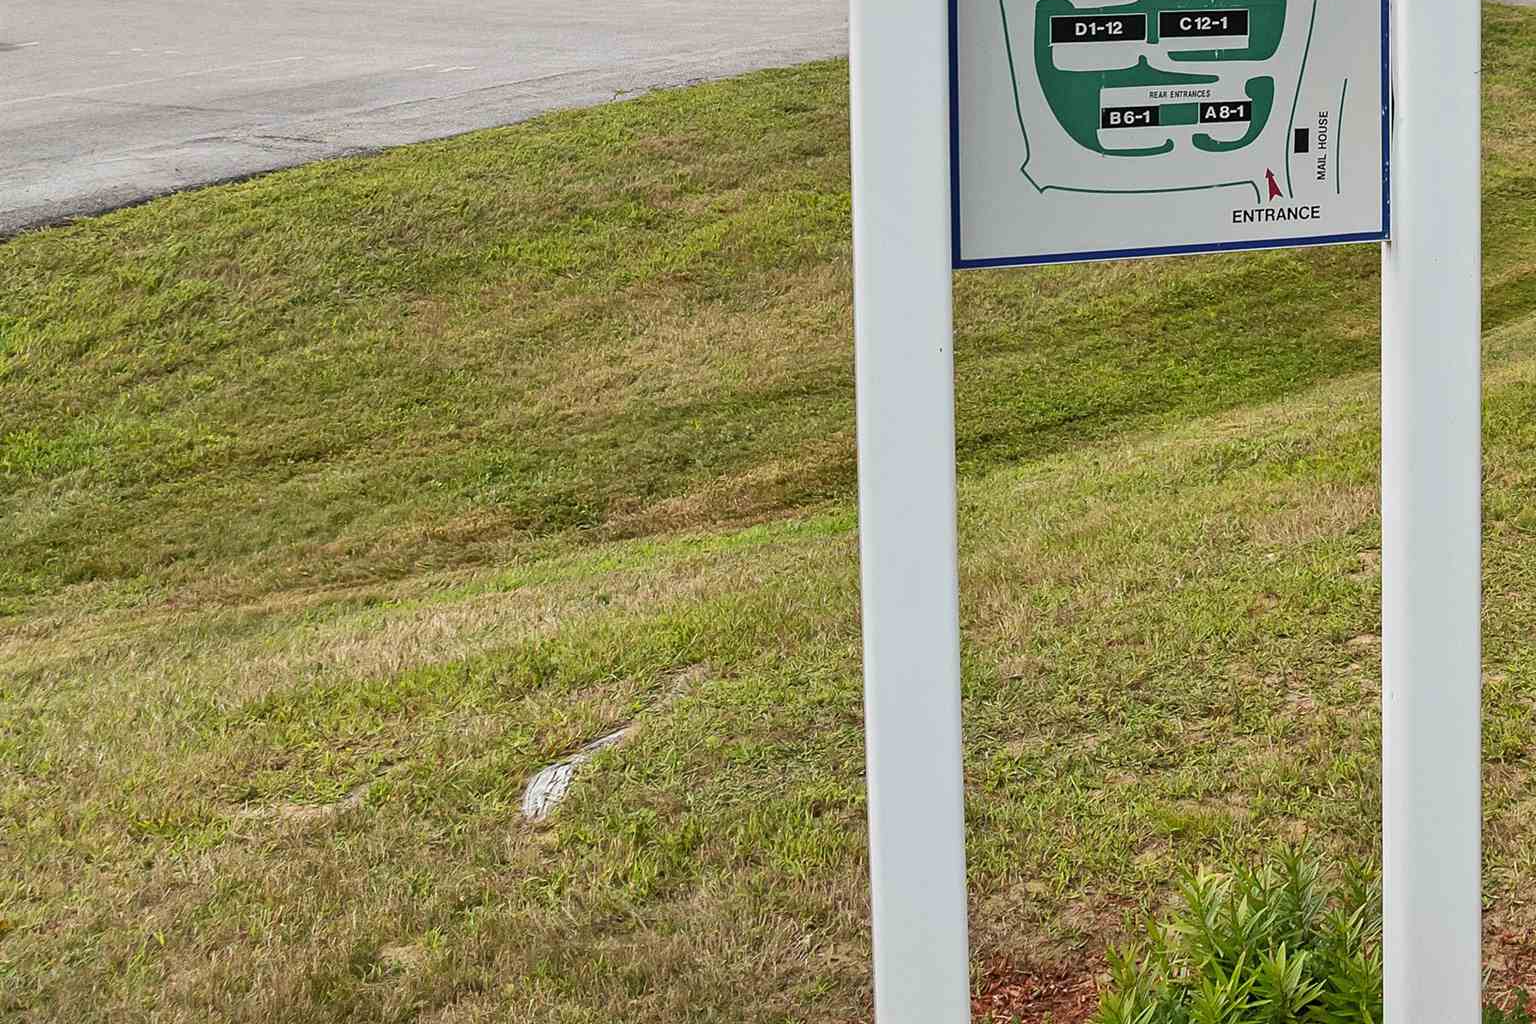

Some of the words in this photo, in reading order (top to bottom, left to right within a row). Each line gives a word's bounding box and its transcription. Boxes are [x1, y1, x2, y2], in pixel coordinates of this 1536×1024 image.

[1149, 91, 1168, 99] REAR
[1170, 89, 1211, 98] ENTRANCES
[1318, 111, 1329, 150] HOUSE
[1316, 154, 1327, 180] MAIL
[1231, 205, 1321, 223] ENTRANCE
